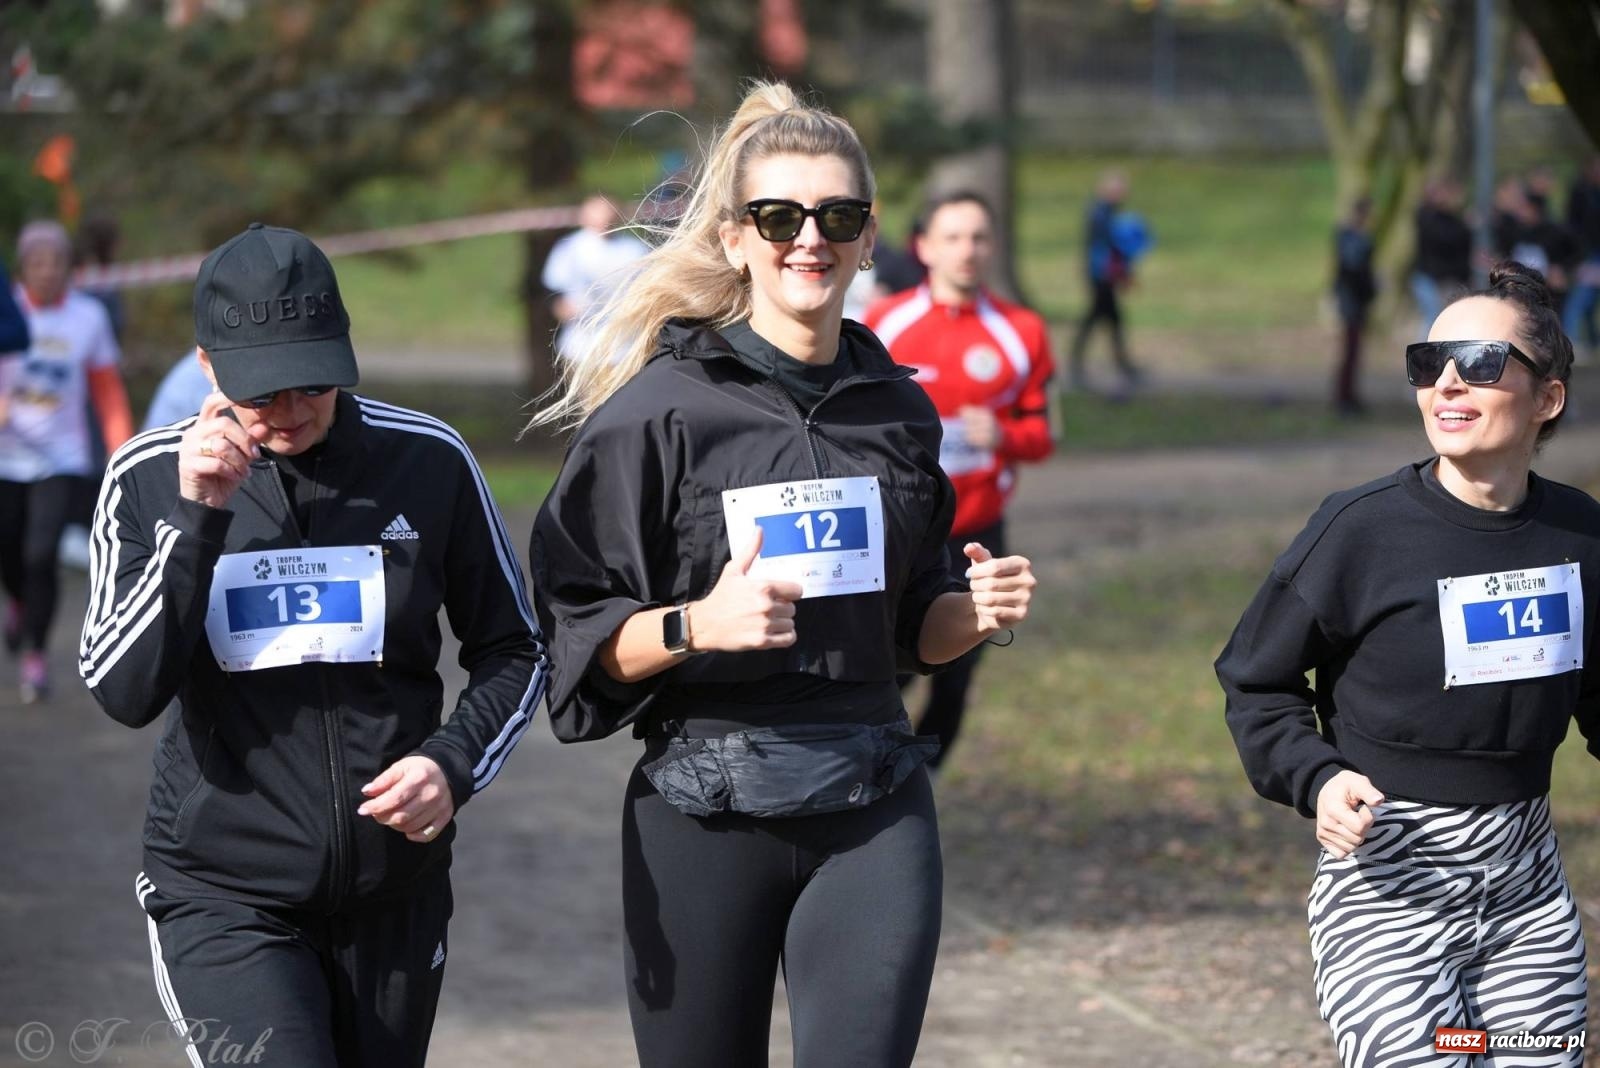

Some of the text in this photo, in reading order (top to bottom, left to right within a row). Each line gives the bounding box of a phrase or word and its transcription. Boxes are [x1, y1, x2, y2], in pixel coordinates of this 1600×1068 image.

[223, 291, 332, 328] GUESS
[803, 489, 843, 503] WILCZYM
[381, 530, 419, 540] adidas
[794, 511, 841, 550] 12
[276, 555, 302, 564] TROPEM
[278, 563, 327, 577] WILCZYM
[1503, 572, 1525, 580] TROPEM
[1505, 577, 1546, 592] WILCZYM
[267, 584, 322, 623] 13
[1498, 598, 1543, 636] 14
[230, 633, 246, 642] 1963
